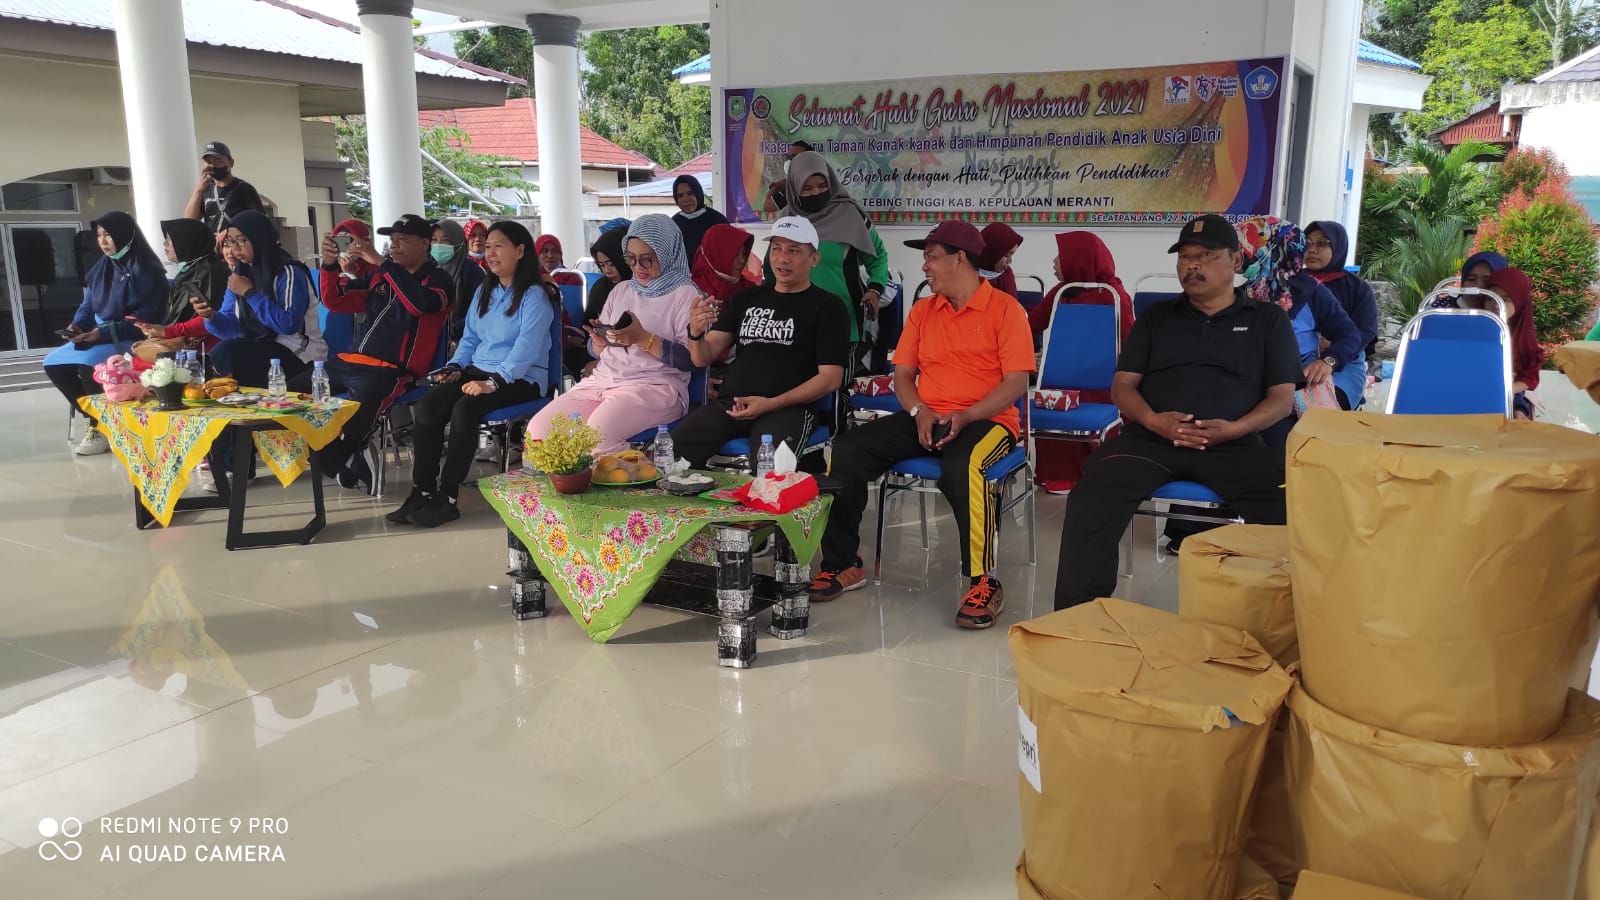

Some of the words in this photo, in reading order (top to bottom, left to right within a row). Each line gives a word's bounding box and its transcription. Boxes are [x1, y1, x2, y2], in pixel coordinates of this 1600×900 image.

[788, 94, 864, 134] Selamat
[864, 88, 919, 132] Hari
[924, 87, 979, 130] Guru
[983, 82, 1090, 128] Nasional
[1094, 79, 1149, 117] 2021
[761, 140, 792, 153] Ikata
[827, 138, 864, 152] Taman
[868, 135, 945, 152] Kanak-kanak
[949, 134, 972, 150] dan
[976, 133, 1042, 152] Himpunan
[1047, 131, 1107, 148] Pendidik
[1111, 129, 1148, 146] Anak
[1153, 127, 1186, 144] Usia
[1191, 126, 1221, 143] Dini
[903, 167, 951, 188] dengan
[953, 165, 993, 186] Hati,
[999, 164, 1071, 185] Pulihkan
[862, 198, 902, 207] TEBING
[906, 198, 944, 207] TINGGI
[948, 198, 975, 207] KAB.
[979, 197, 1051, 207] KEPULAUAN
[1056, 196, 1114, 207] MERANTI
[1091, 214, 1163, 223] SELATPANJANG,
[1167, 214, 1178, 222] 27
[746, 307, 775, 320] KOPI
[742, 316, 794, 329] LIBERIKA
[740, 325, 794, 339] MERANTI
